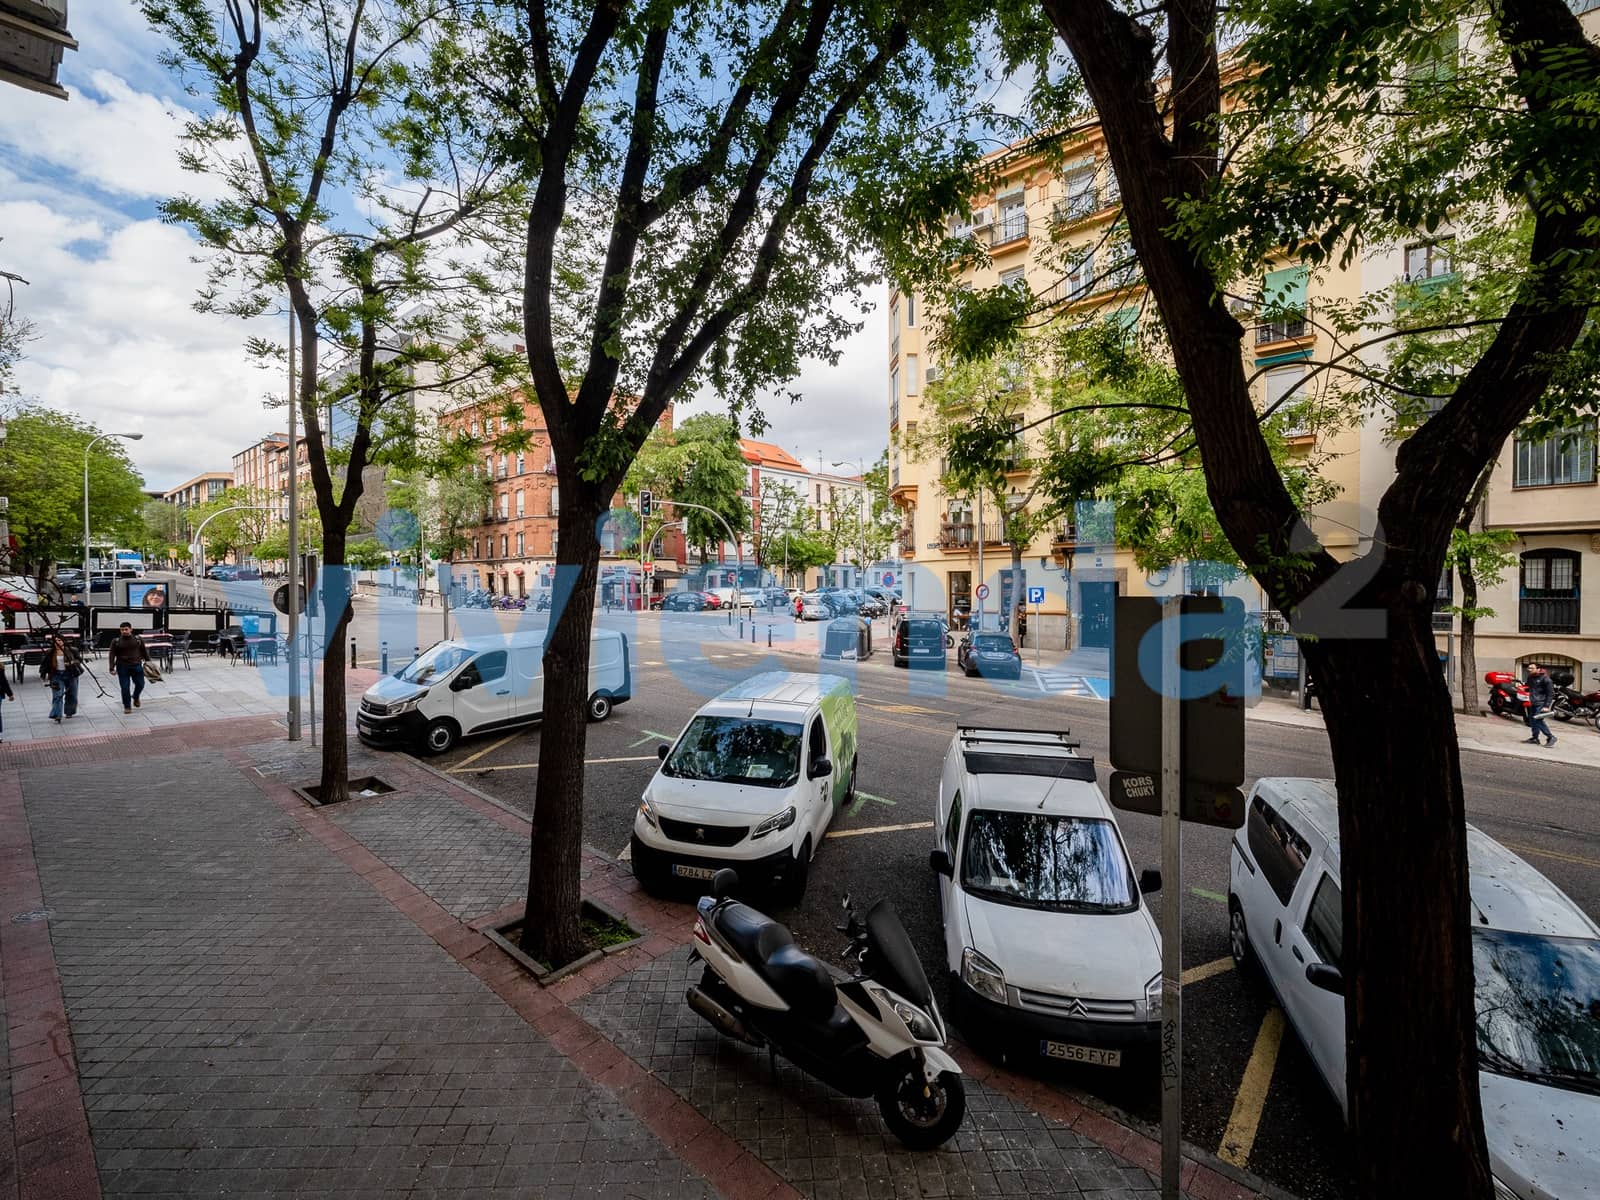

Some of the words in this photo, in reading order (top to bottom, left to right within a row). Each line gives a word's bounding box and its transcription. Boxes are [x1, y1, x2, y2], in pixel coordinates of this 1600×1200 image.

[1031, 588, 1042, 602] P
[1122, 776, 1153, 788] KORS
[1126, 785, 1155, 798] CHUKY
[1048, 1043, 1084, 1060] 2556
[1089, 1050, 1116, 1065] FYP
